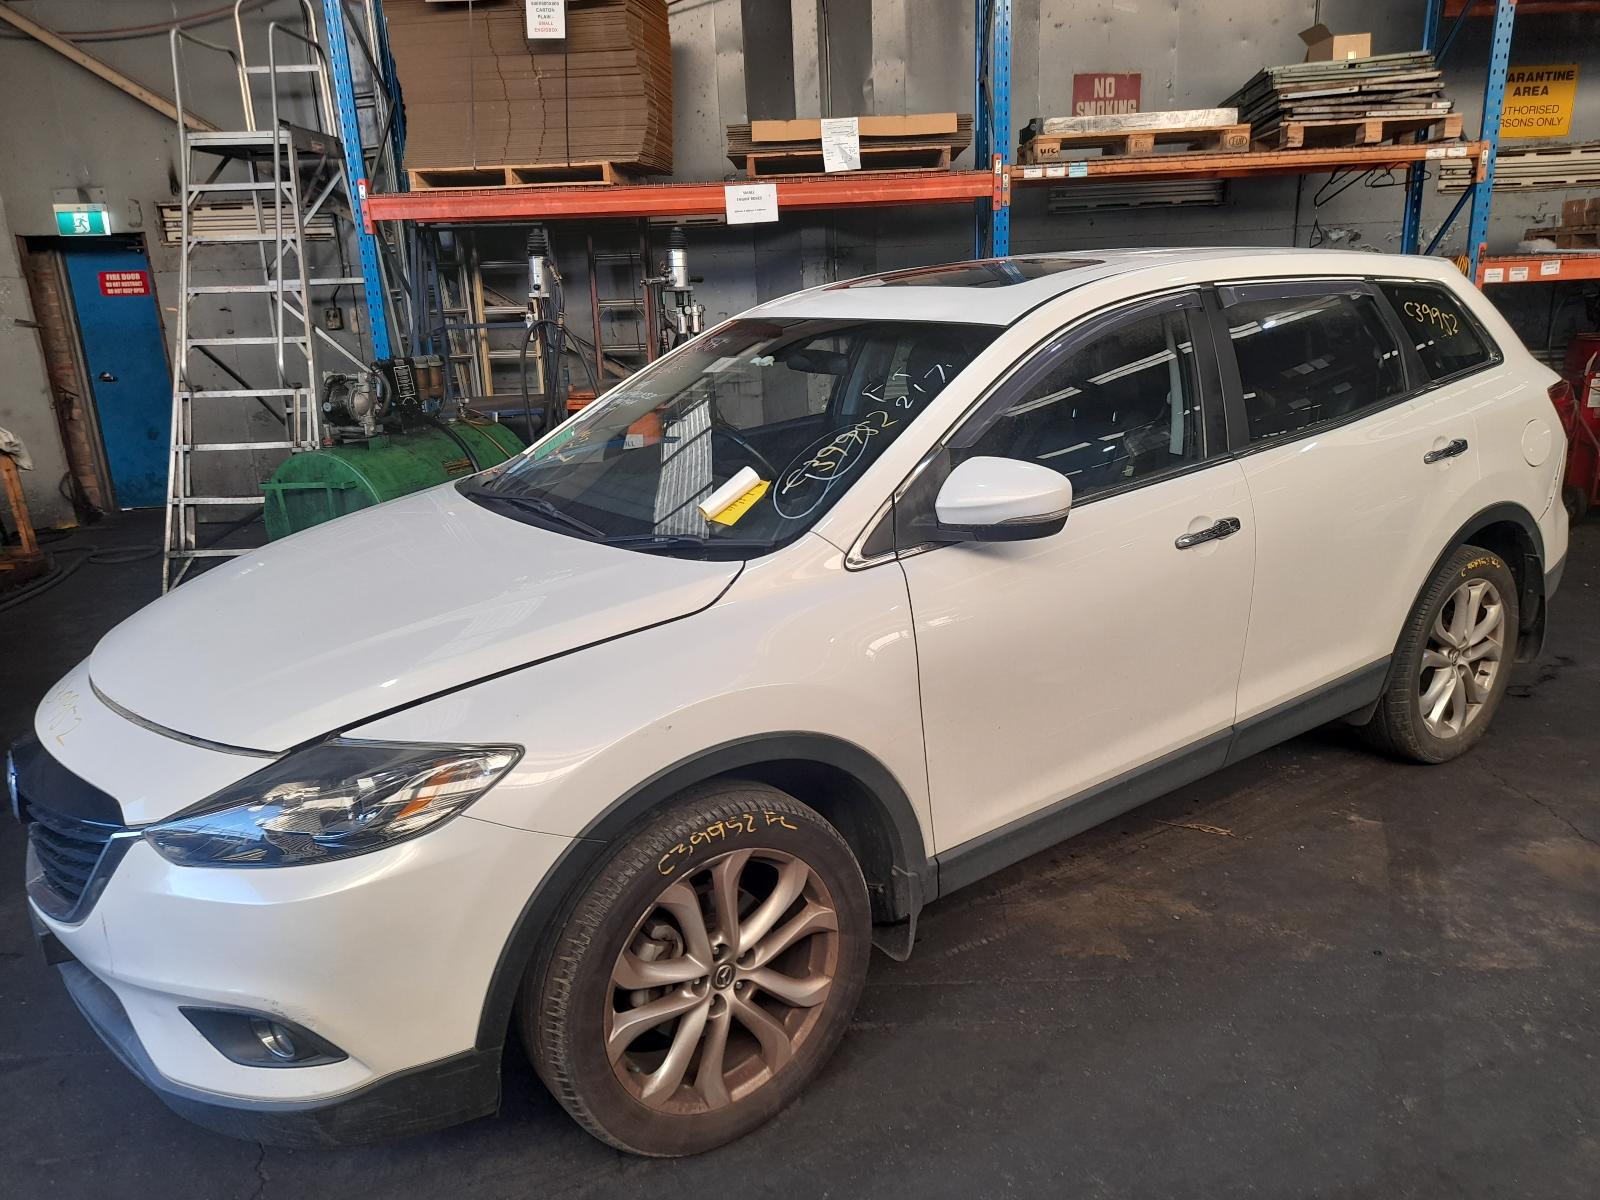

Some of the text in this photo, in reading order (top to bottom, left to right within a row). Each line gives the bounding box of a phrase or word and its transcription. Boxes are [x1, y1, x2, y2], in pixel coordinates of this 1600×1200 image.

[1506, 70, 1575, 83] ARANTINE
[1094, 77, 1116, 98] NO
[1513, 86, 1549, 97] AREA
[1076, 99, 1137, 117] SMOKING
[1501, 104, 1560, 116] UTHORISED
[1536, 117, 1564, 127] ONLY
[121, 272, 141, 280] DOOR
